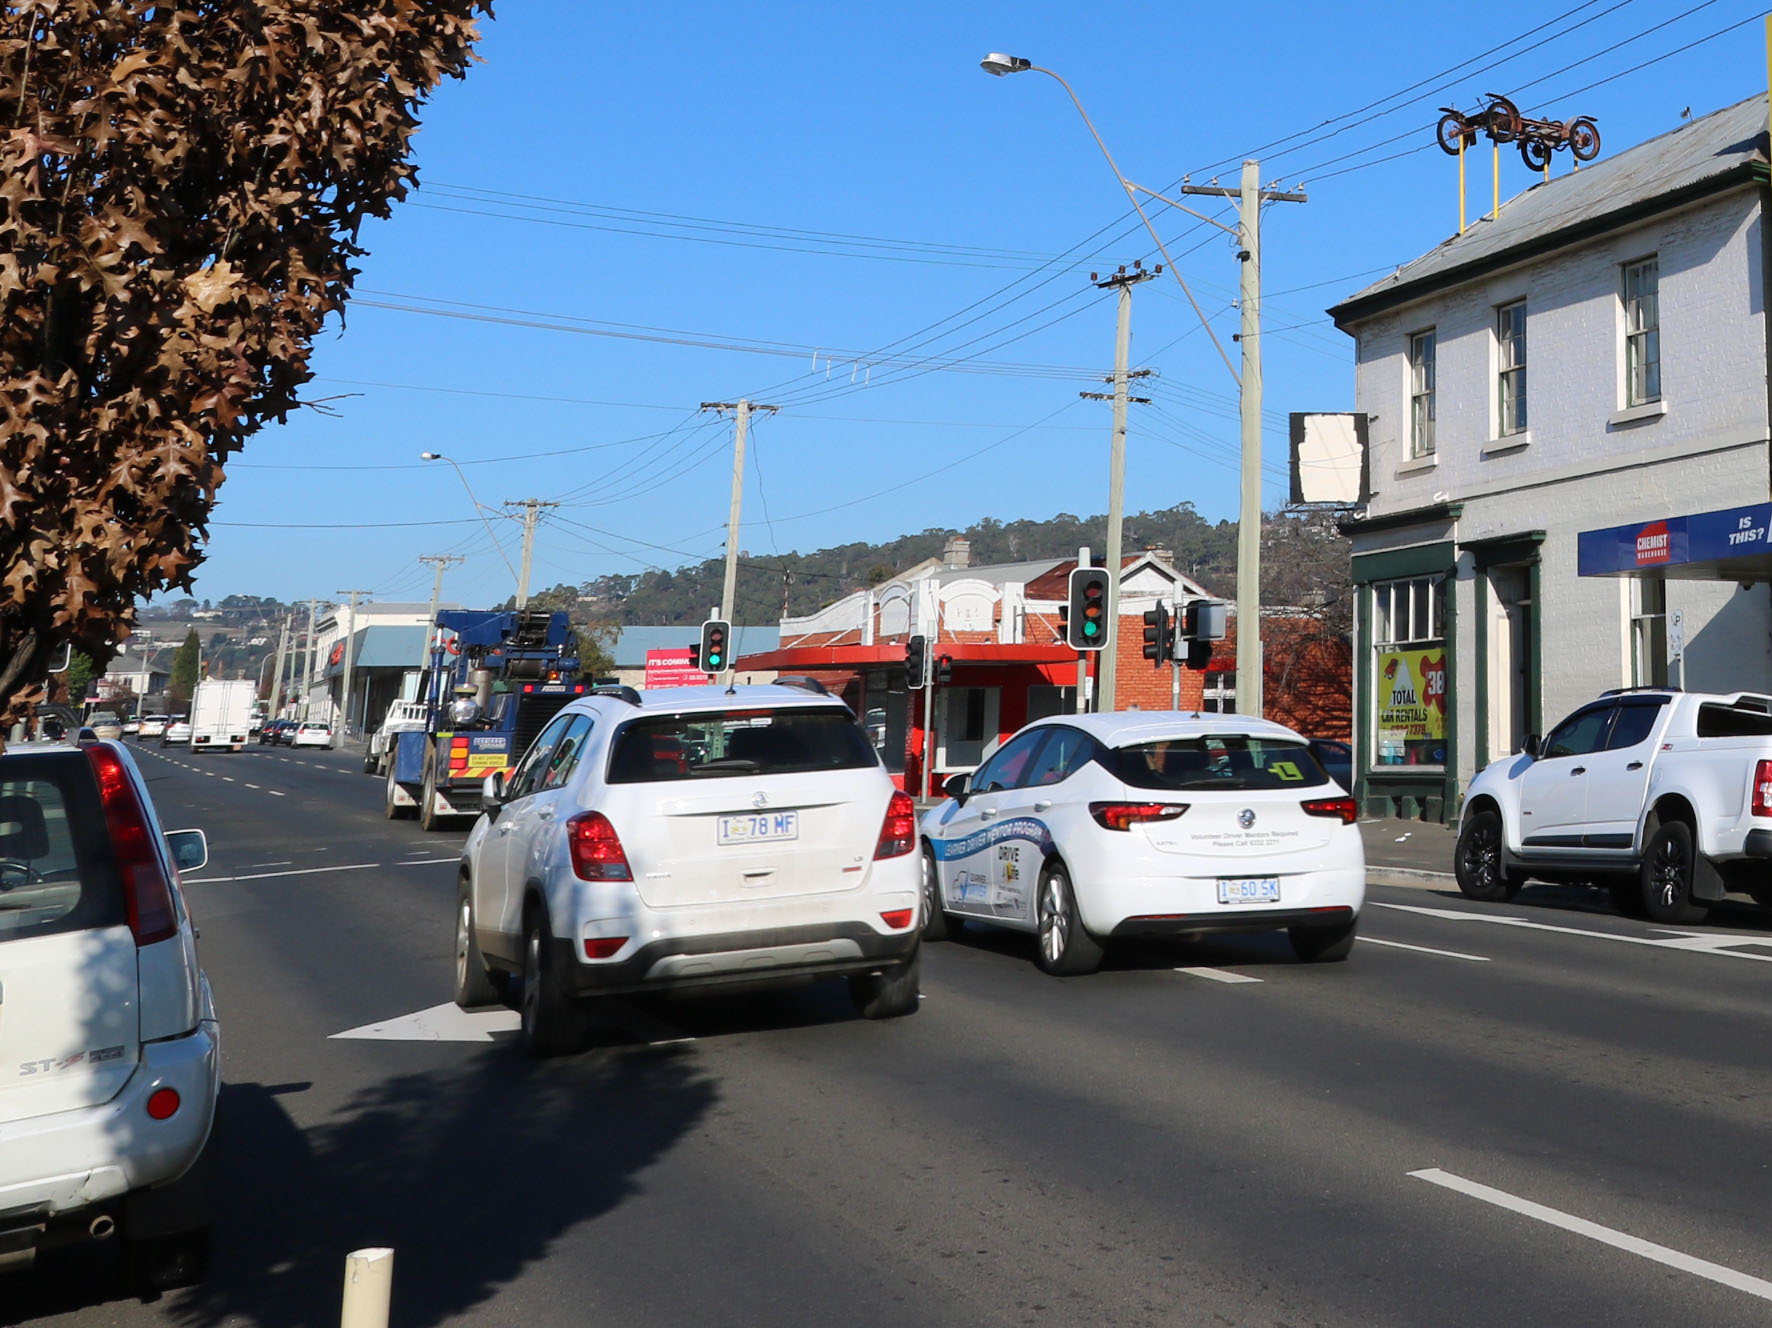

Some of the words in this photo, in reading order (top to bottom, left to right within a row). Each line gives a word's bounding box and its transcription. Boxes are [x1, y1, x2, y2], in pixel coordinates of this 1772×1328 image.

[1739, 516, 1752, 530] IS
[1637, 534, 1668, 551] CHEMIST
[1728, 528, 1765, 545] THIS?
[1392, 689, 1417, 706] TOTAL
[1395, 708, 1428, 723] RENTALS
[999, 846, 1019, 863] DRIVE
